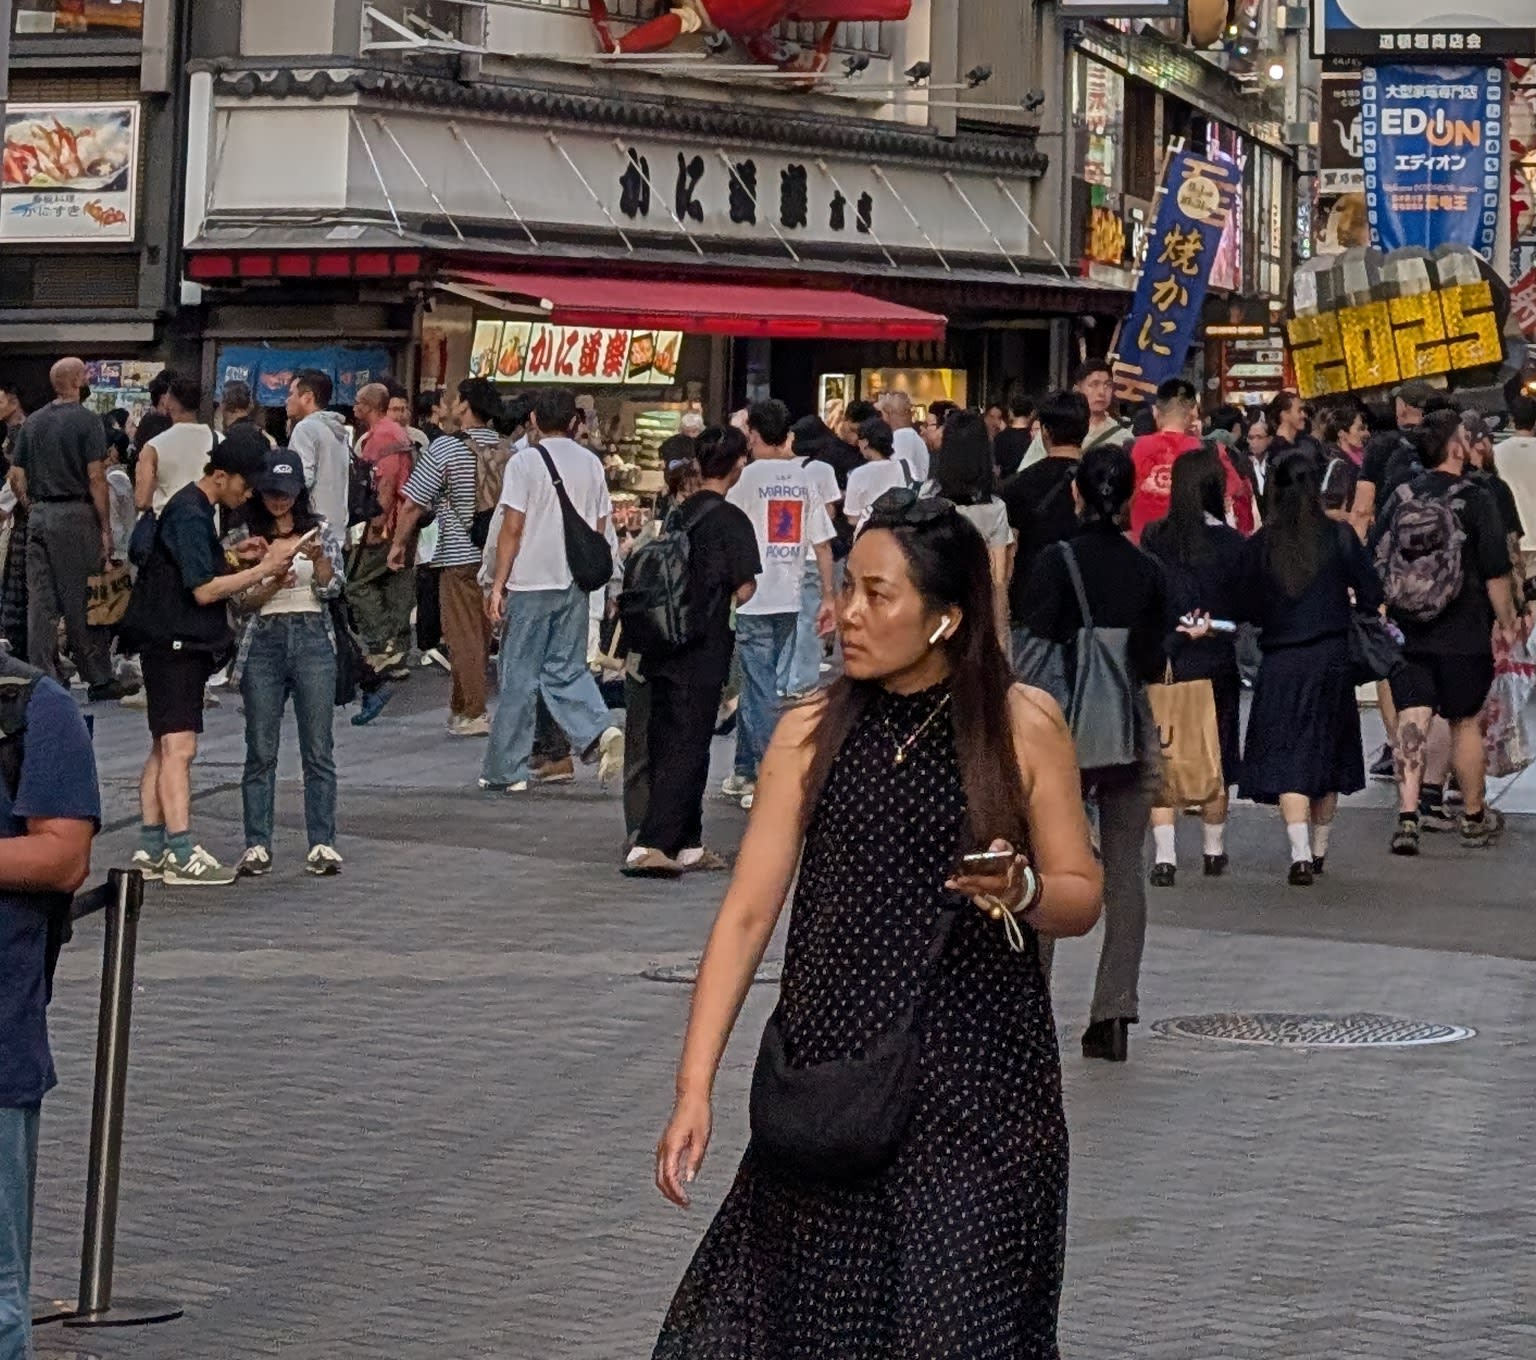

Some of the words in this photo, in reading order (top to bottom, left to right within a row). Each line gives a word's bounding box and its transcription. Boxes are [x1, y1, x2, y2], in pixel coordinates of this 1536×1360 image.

[1380, 108, 1481, 147] EDION
[1394, 153, 1467, 172] エディオン
[1137, 224, 1205, 356] 焼かに
[528, 326, 629, 377] かに道楽
